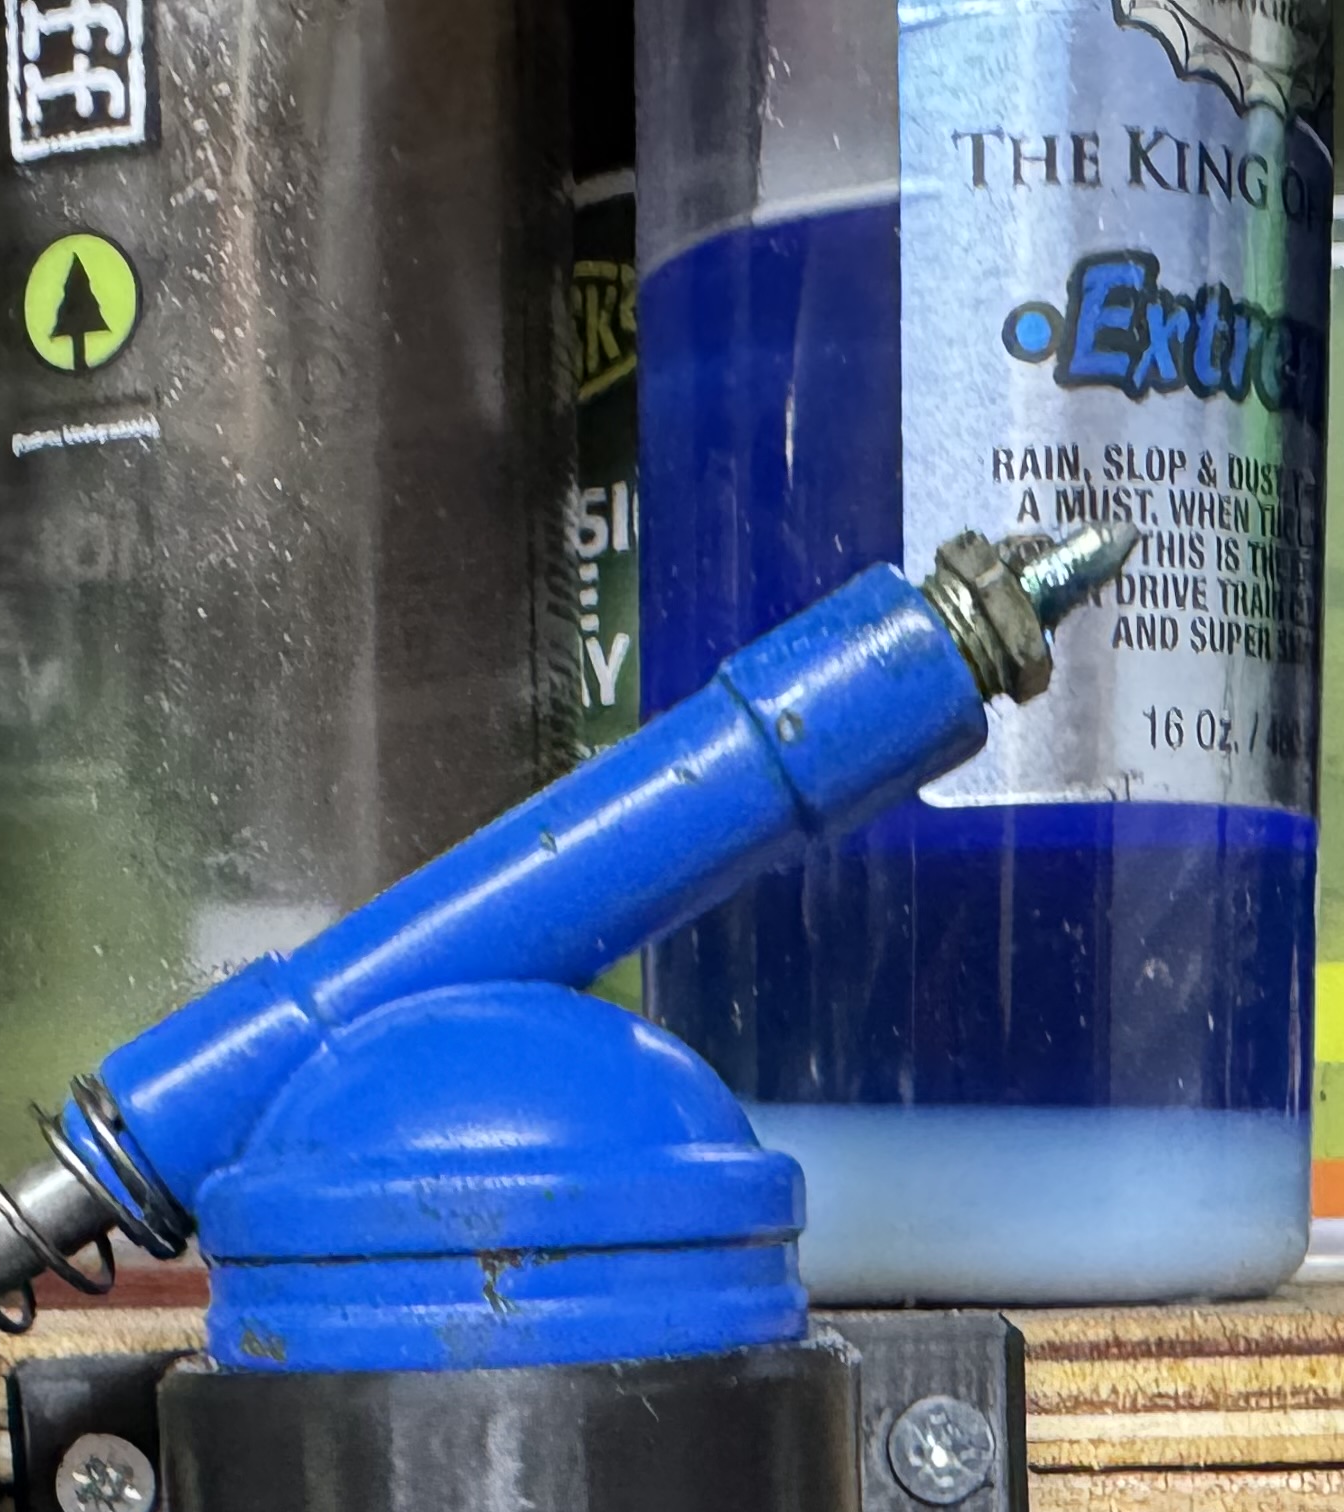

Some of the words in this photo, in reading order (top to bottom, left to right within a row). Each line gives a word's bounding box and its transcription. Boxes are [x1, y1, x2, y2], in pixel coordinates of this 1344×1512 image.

[952, 125, 1101, 189] THE
[1124, 123, 1267, 211] KING
[991, 444, 1091, 489] RAIN,
[1102, 442, 1188, 484] SLOP
[1197, 450, 1218, 490] &
[1016, 488, 1040, 524] A
[1055, 487, 1157, 525] MUST.
[1167, 489, 1250, 535] WHEN
[1140, 530, 1206, 571] THIS
[1215, 534, 1241, 573] IS
[1114, 573, 1208, 613] DRIVE
[1111, 614, 1180, 652] AND
[1189, 614, 1272, 663] SUPER
[1142, 703, 1185, 751] 16
